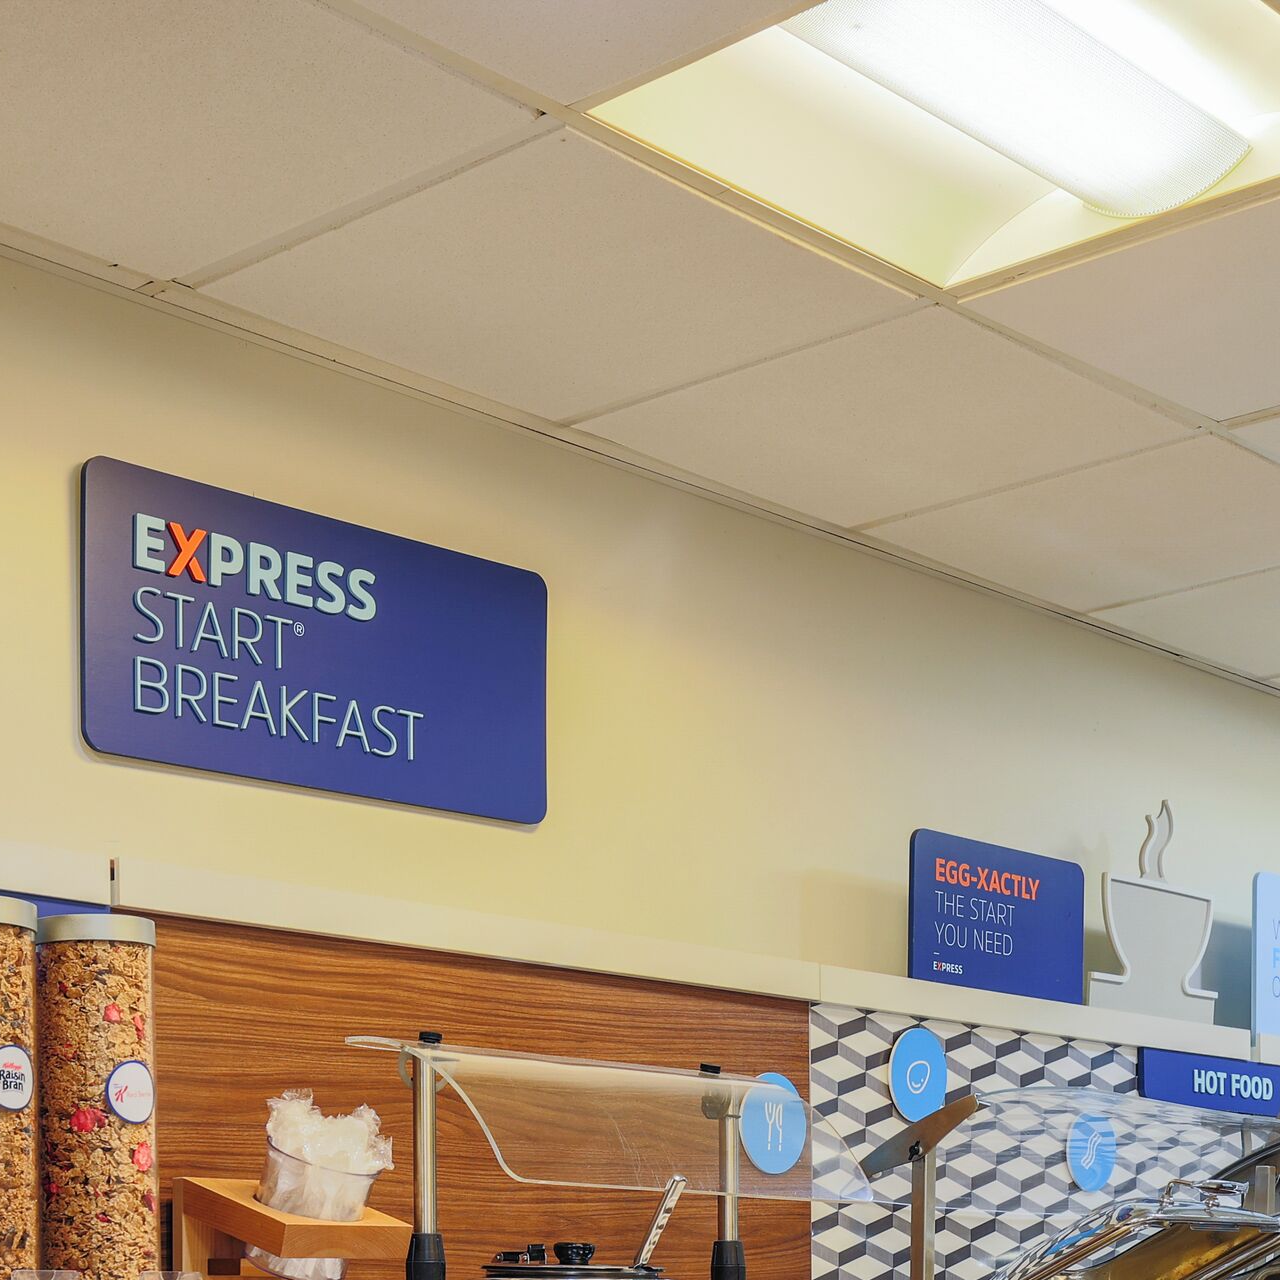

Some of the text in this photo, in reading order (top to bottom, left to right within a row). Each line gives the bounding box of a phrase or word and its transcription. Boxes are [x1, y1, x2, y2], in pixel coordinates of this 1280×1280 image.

[132, 512, 377, 622] EXPRESS
[133, 655, 424, 761] BREAKFAST
[935, 858, 1040, 901] EGG-XACTLY
[935, 890, 1015, 927] THE START
[934, 921, 1013, 956] YOU NEED
[933, 961, 963, 975] EXPRESS
[0, 1069, 25, 1082] Raisin
[3, 1080, 23, 1091] Bran
[1193, 1068, 1274, 1101] HOT FOOD
